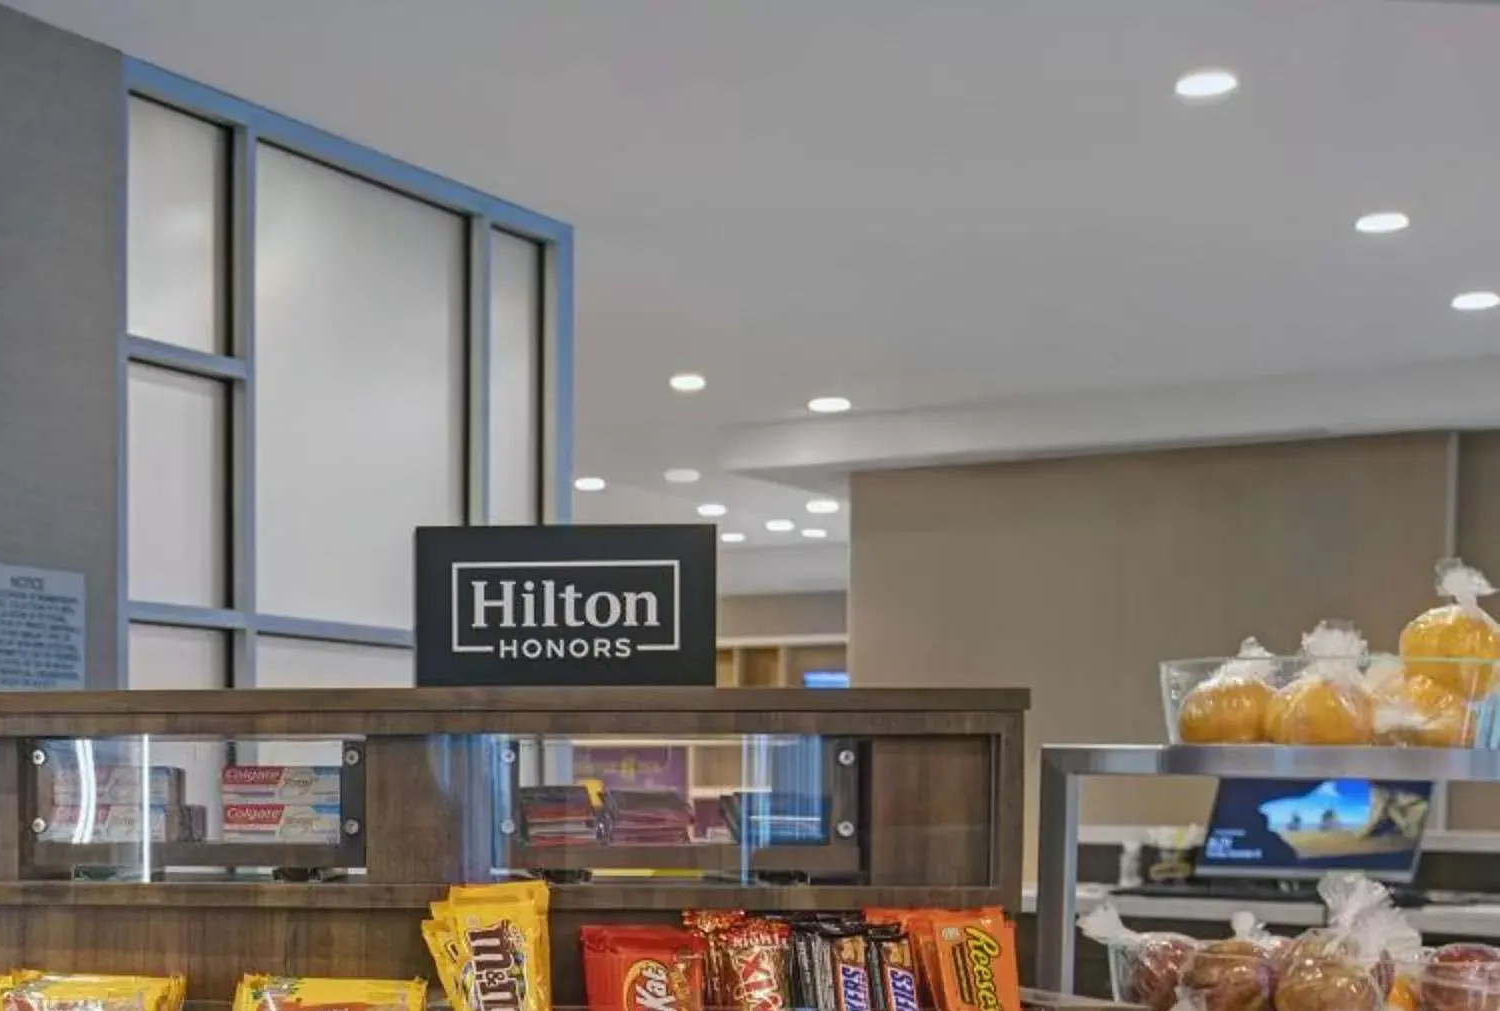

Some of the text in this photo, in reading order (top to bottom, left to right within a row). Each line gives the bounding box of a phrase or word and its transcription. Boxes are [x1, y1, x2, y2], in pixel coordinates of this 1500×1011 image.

[471, 579, 661, 628] Hilton
[499, 638, 632, 659] HONORS
[227, 807, 282, 823] Colgate
